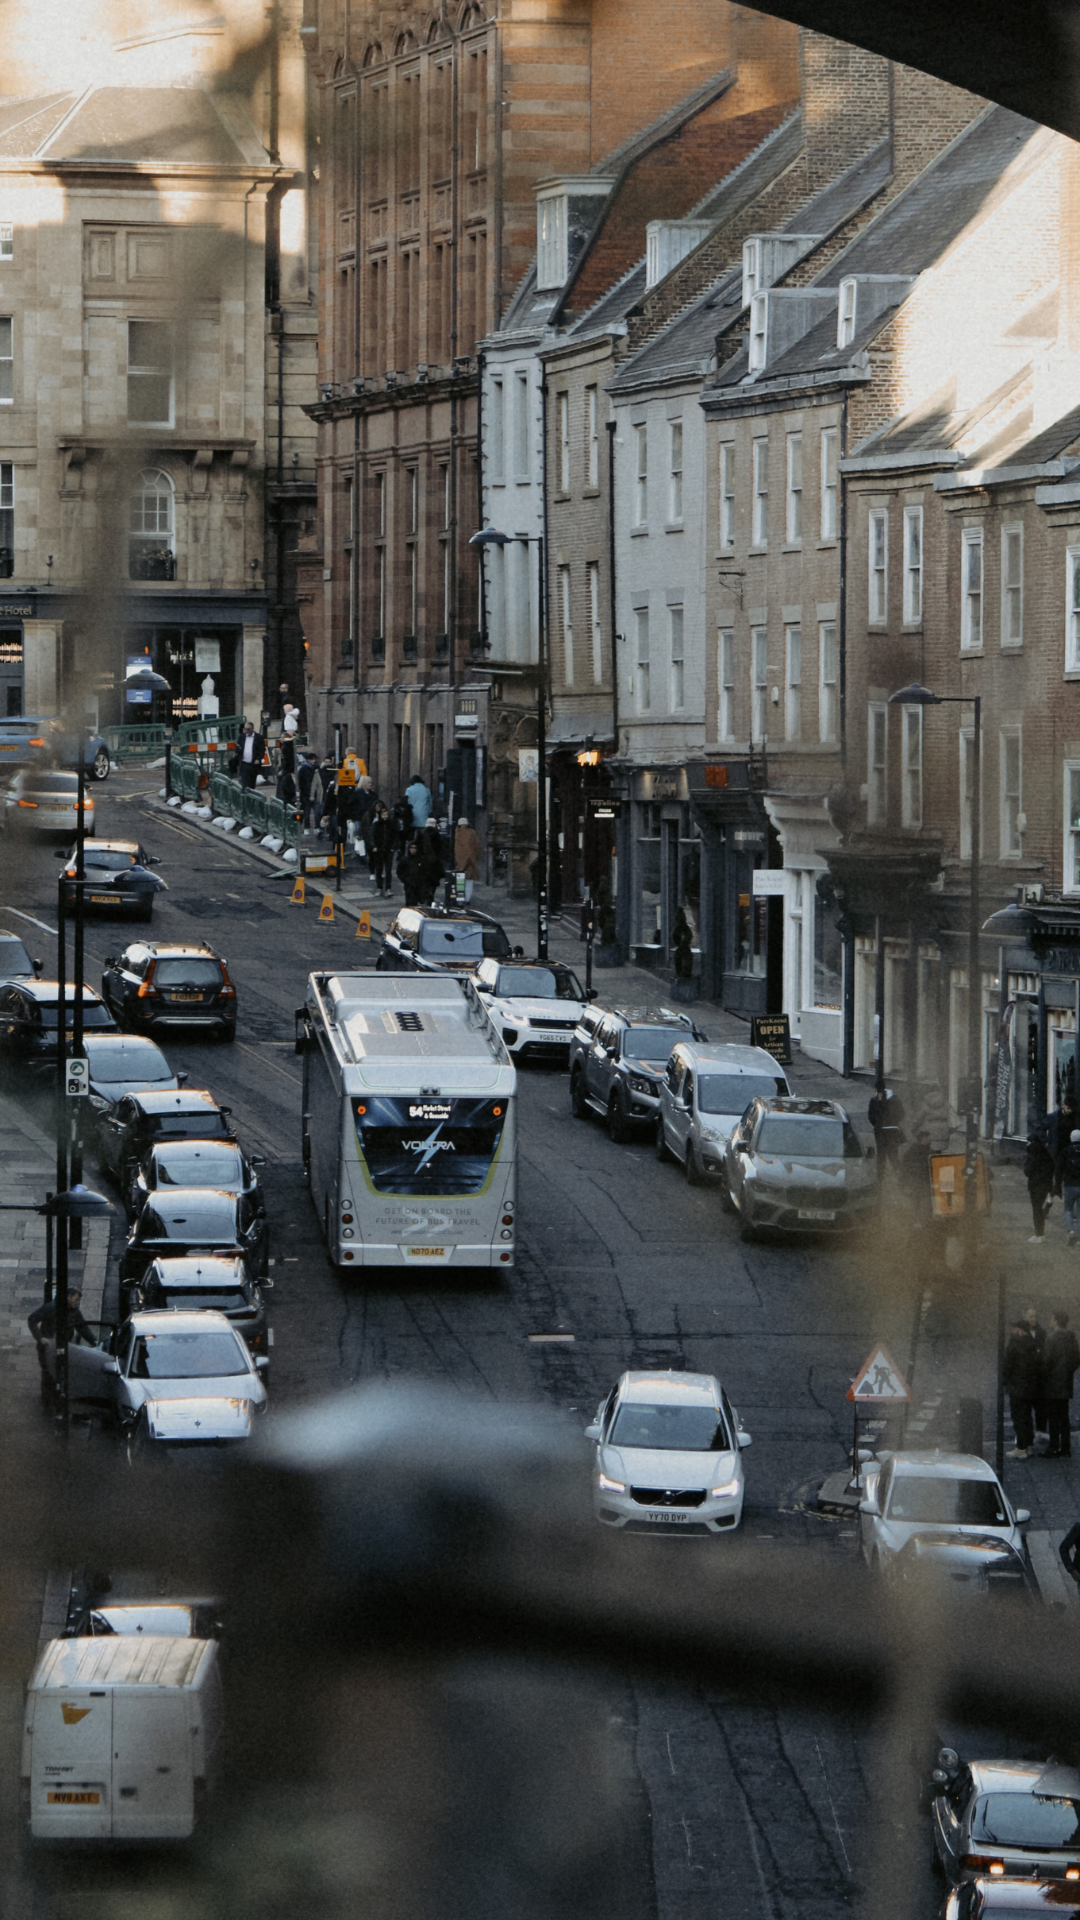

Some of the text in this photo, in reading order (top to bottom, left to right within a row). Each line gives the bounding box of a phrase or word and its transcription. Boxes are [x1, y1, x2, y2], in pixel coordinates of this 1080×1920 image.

[5, 605, 32, 615] Hotel
[760, 1025, 784, 1035] OPEN
[997, 1047, 1005, 1108] MOUNTAIN
[1001, 1064, 1010, 1109] CENTRE
[409, 1105, 423, 1117] 54
[401, 1140, 456, 1150] VOLTRA
[649, 1513, 670, 1521] YY70
